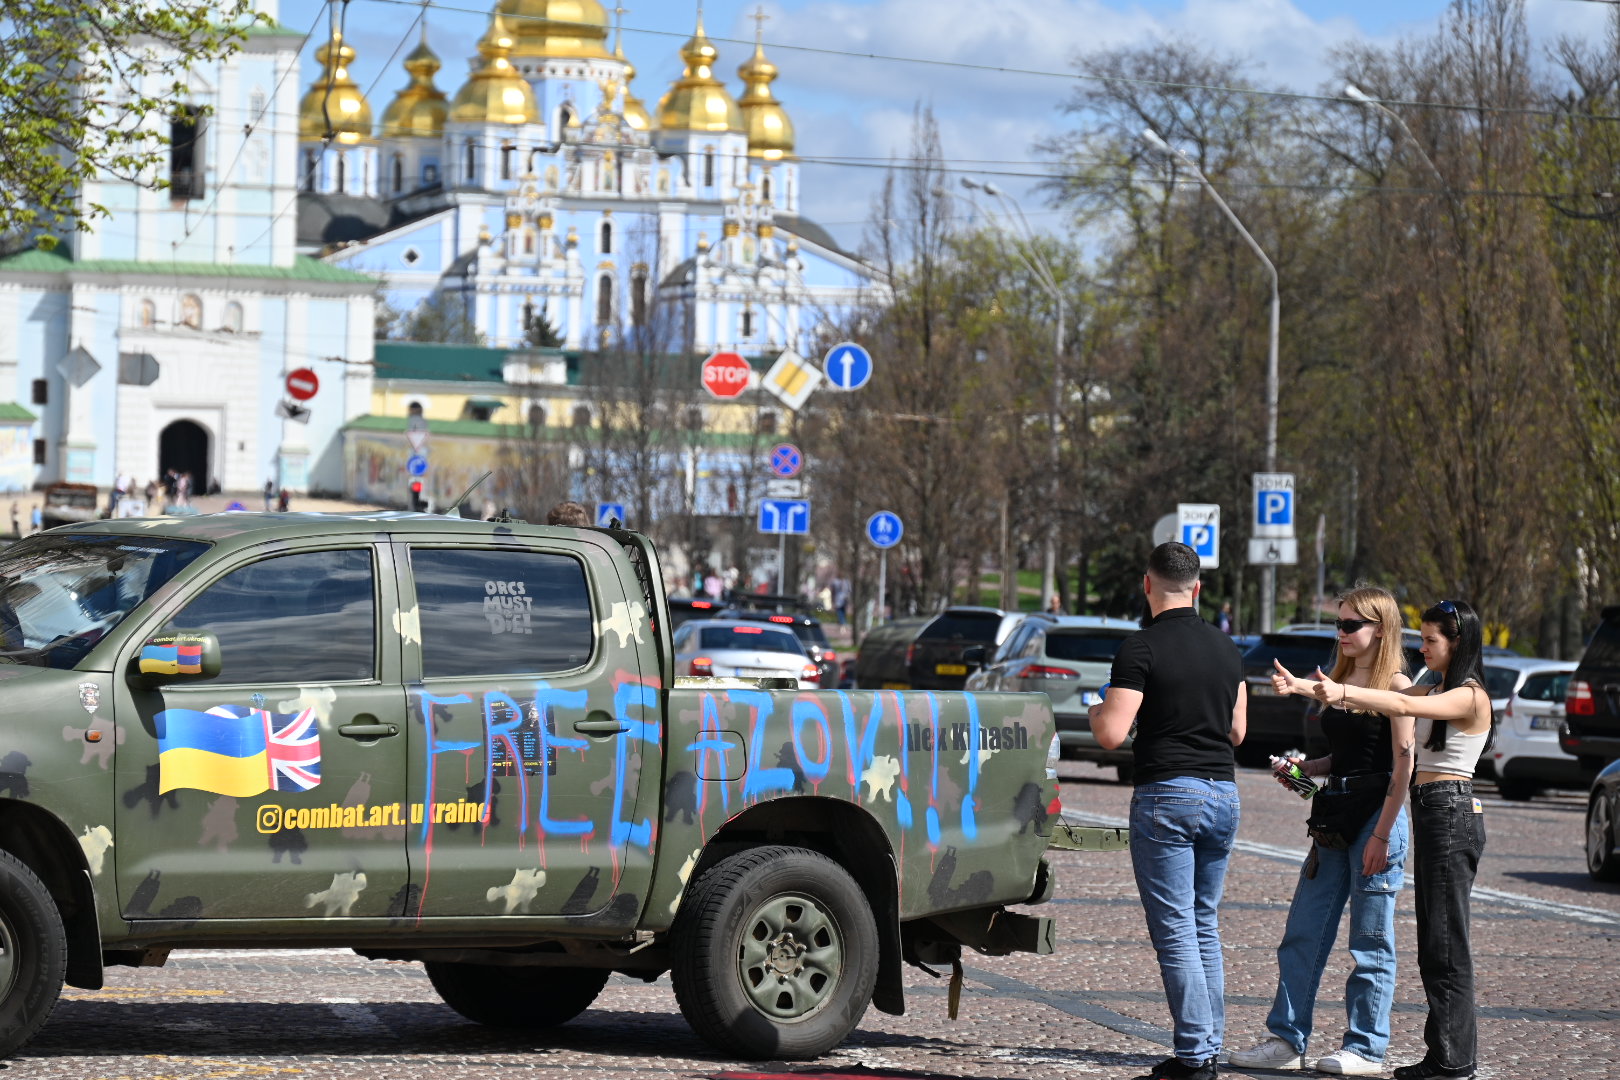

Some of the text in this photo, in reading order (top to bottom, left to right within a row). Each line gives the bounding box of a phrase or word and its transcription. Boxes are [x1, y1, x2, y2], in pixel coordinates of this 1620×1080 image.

[704, 366, 748, 383] STOP
[1258, 478, 1294, 489] ЗОНА
[1265, 493, 1286, 523] P
[1191, 526, 1210, 556] P
[485, 581, 526, 595] ORCS
[483, 596, 533, 613] MUST
[485, 611, 533, 634] DIE!
[417, 678, 661, 850] FREE
